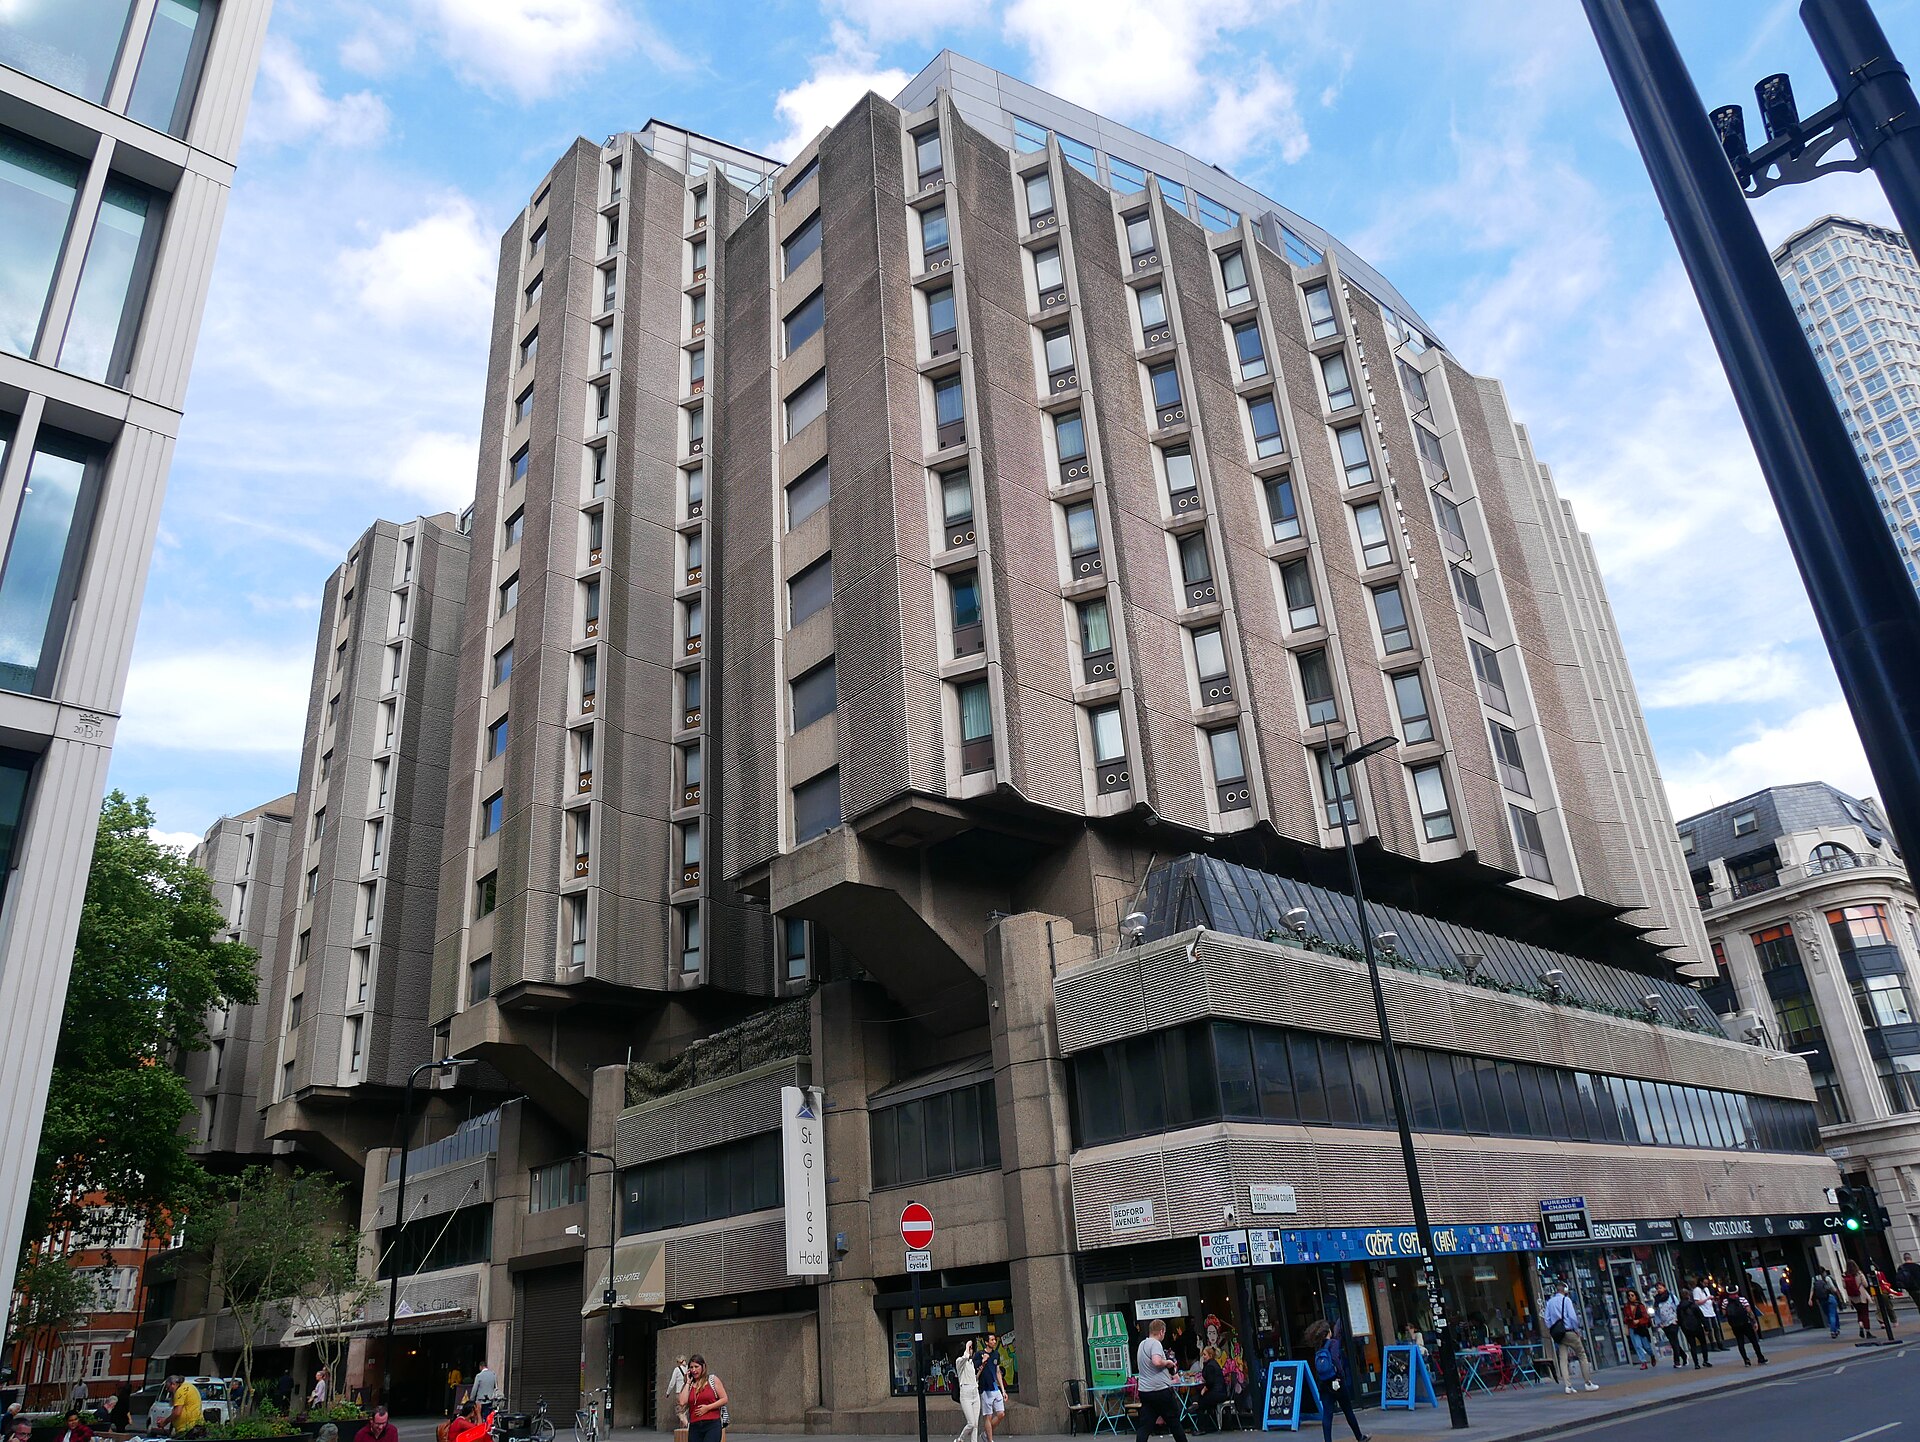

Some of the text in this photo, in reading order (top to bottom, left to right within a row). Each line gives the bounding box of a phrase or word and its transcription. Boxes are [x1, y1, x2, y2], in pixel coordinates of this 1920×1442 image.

[801, 1126, 813, 1145] St
[1253, 1193, 1294, 1202] TOTTENHAM COURT
[1542, 1198, 1570, 1206] BUREAU
[1253, 1202, 1267, 1210] ROAD
[1113, 1206, 1144, 1218] BEDFORD
[1548, 1213, 1581, 1222] MOBILE PHONE
[1115, 1216, 1141, 1227] AVENUE
[1554, 1222, 1574, 1231] TABLETS
[1788, 1219, 1805, 1230] CASINO
[1592, 1223, 1638, 1239] ECH OUTLET
[1708, 1220, 1754, 1236] SLOTS LOUNGE
[1550, 1230, 1586, 1240] LAPTOP REPAIRS
[1211, 1244, 1237, 1255] COFFEE
[799, 1250, 823, 1265] Hotel
[909, 1261, 928, 1270] cycles
[622, 1271, 641, 1283] HOTEL
[431, 1297, 459, 1310] Giles
